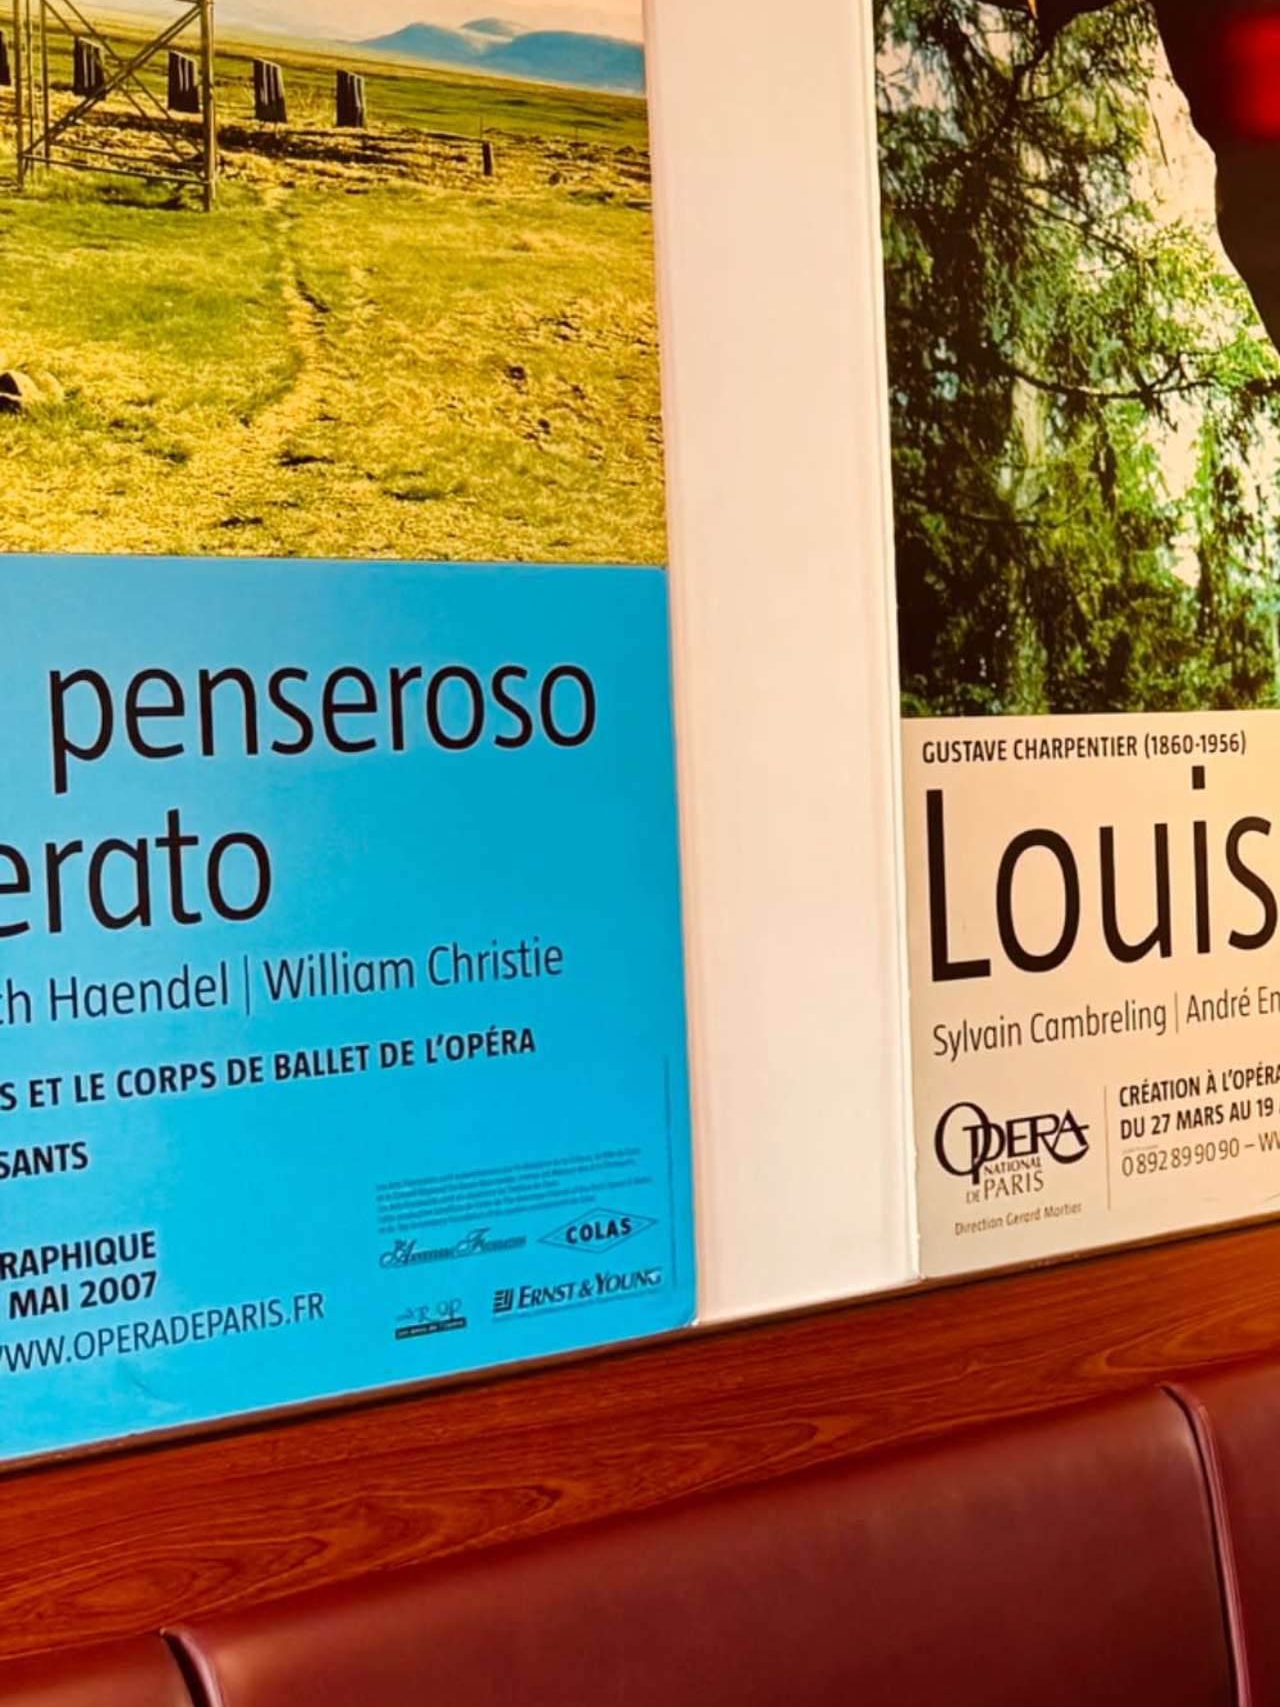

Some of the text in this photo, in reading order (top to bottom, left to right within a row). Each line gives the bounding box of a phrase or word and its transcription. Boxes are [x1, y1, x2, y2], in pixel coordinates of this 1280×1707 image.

[49, 664, 596, 794] penseroso
[922, 730, 1246, 763] GUSTAVE CHARPENTIER (1860-1956)
[49, 961, 228, 1022] Haendel
[263, 952, 414, 1001] William
[428, 936, 563, 987] Christie
[933, 1015, 1023, 1060] Sylvain
[1030, 1000, 1167, 1049] Cambreling
[1186, 986, 1250, 1025] André
[30, 1077, 61, 1108] ET
[75, 1073, 104, 1104] LE
[116, 1061, 216, 1097] CORPS
[227, 1057, 263, 1087] DE
[275, 1045, 369, 1080] BALLET
[380, 1038, 414, 1069] DE
[426, 1025, 535, 1064] L'OPÉRA
[1120, 1076, 1200, 1107] CRÉATION
[1206, 1069, 1217, 1093] À
[1121, 1118, 1145, 1140] DU
[1151, 1114, 1171, 1135] 27
[1176, 1104, 1224, 1131] MARS
[1229, 1100, 1251, 1123] AU
[1257, 1097, 1273, 1118] 19
[983, 1157, 1042, 1175] NATIONAL
[983, 1170, 1045, 1200] PARIS
[565, 1217, 632, 1244] COLAS
[10, 1271, 157, 1319] MAI 2007
[518, 1282, 575, 1308] ERNST
[579, 1278, 592, 1298] &
[594, 1267, 661, 1295] YOUNG
[0, 1292, 324, 1372] WW.OPERADEPARIS.FR
